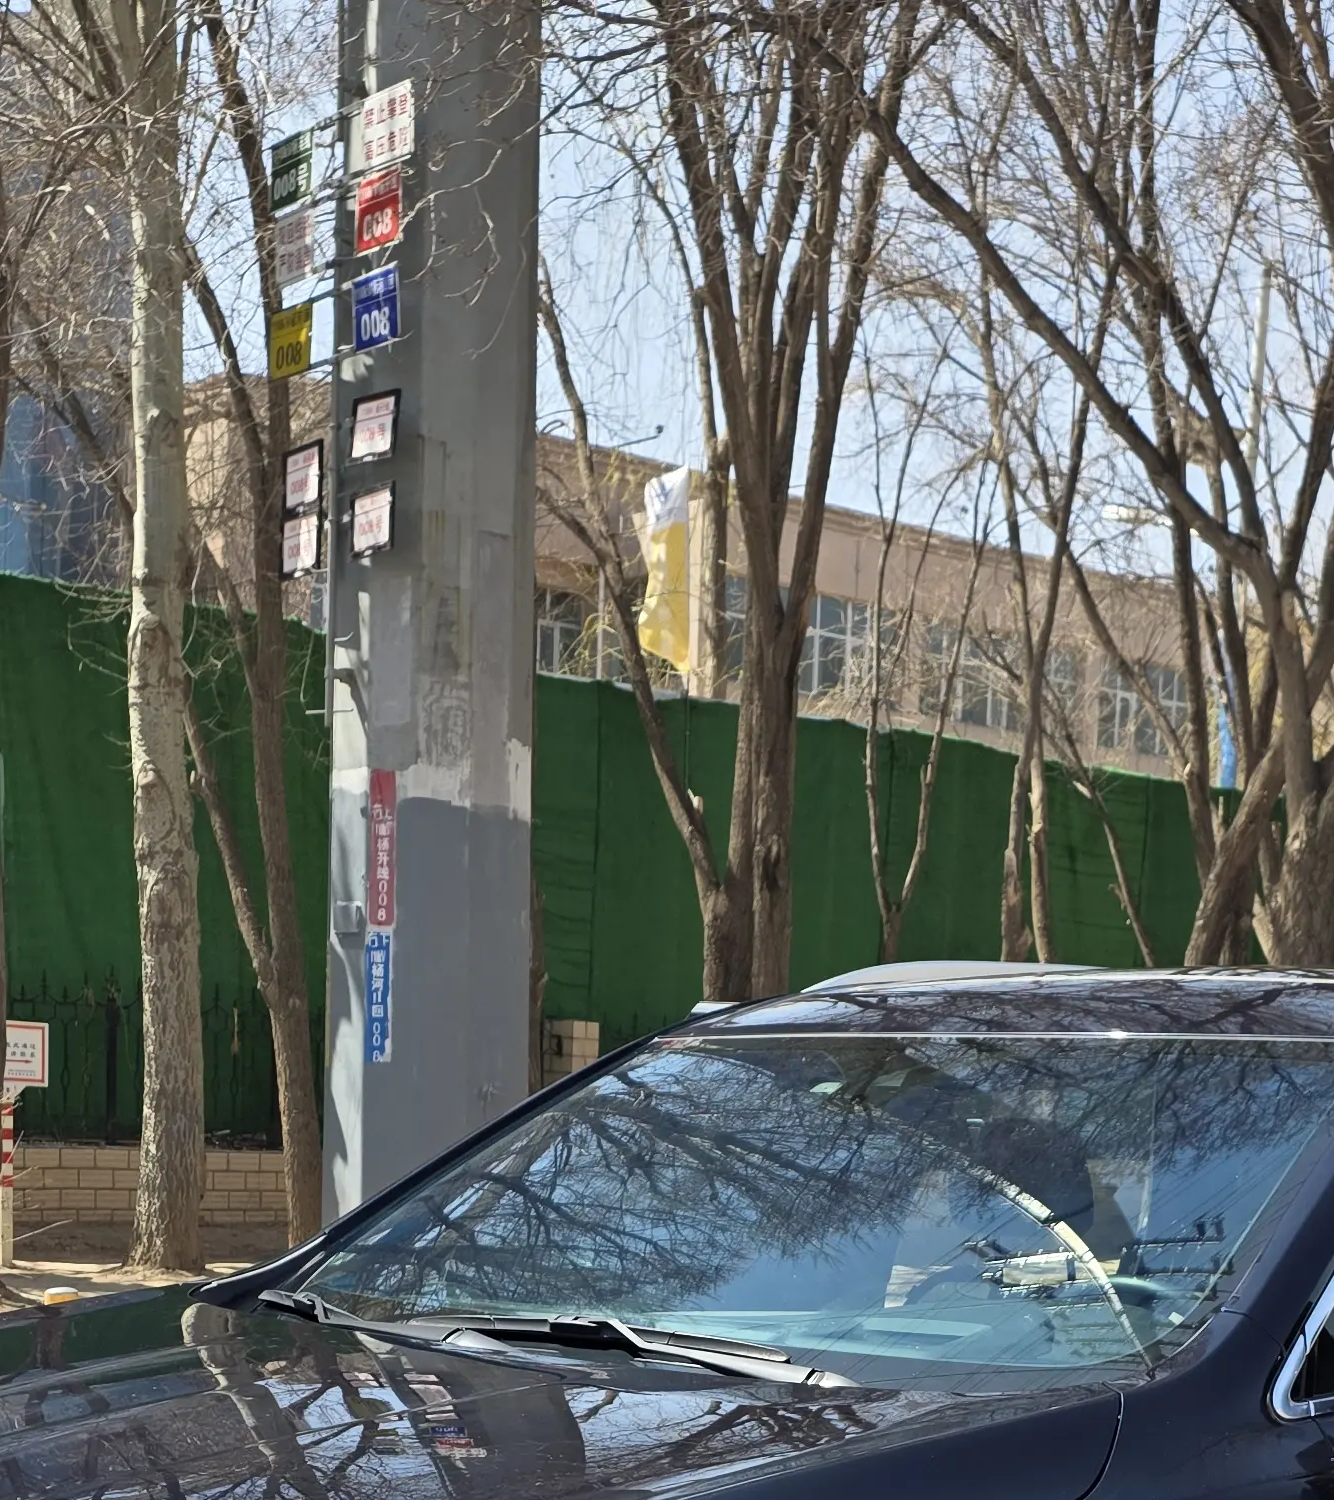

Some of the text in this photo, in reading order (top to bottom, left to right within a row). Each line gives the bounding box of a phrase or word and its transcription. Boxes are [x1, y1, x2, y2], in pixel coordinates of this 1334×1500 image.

[364, 93, 408, 129] 禁止攀登
[364, 125, 408, 161] 高压危险
[273, 162, 309, 201] 008号
[363, 208, 393, 241] 008
[361, 306, 390, 341] 008
[276, 340, 302, 370] 008
